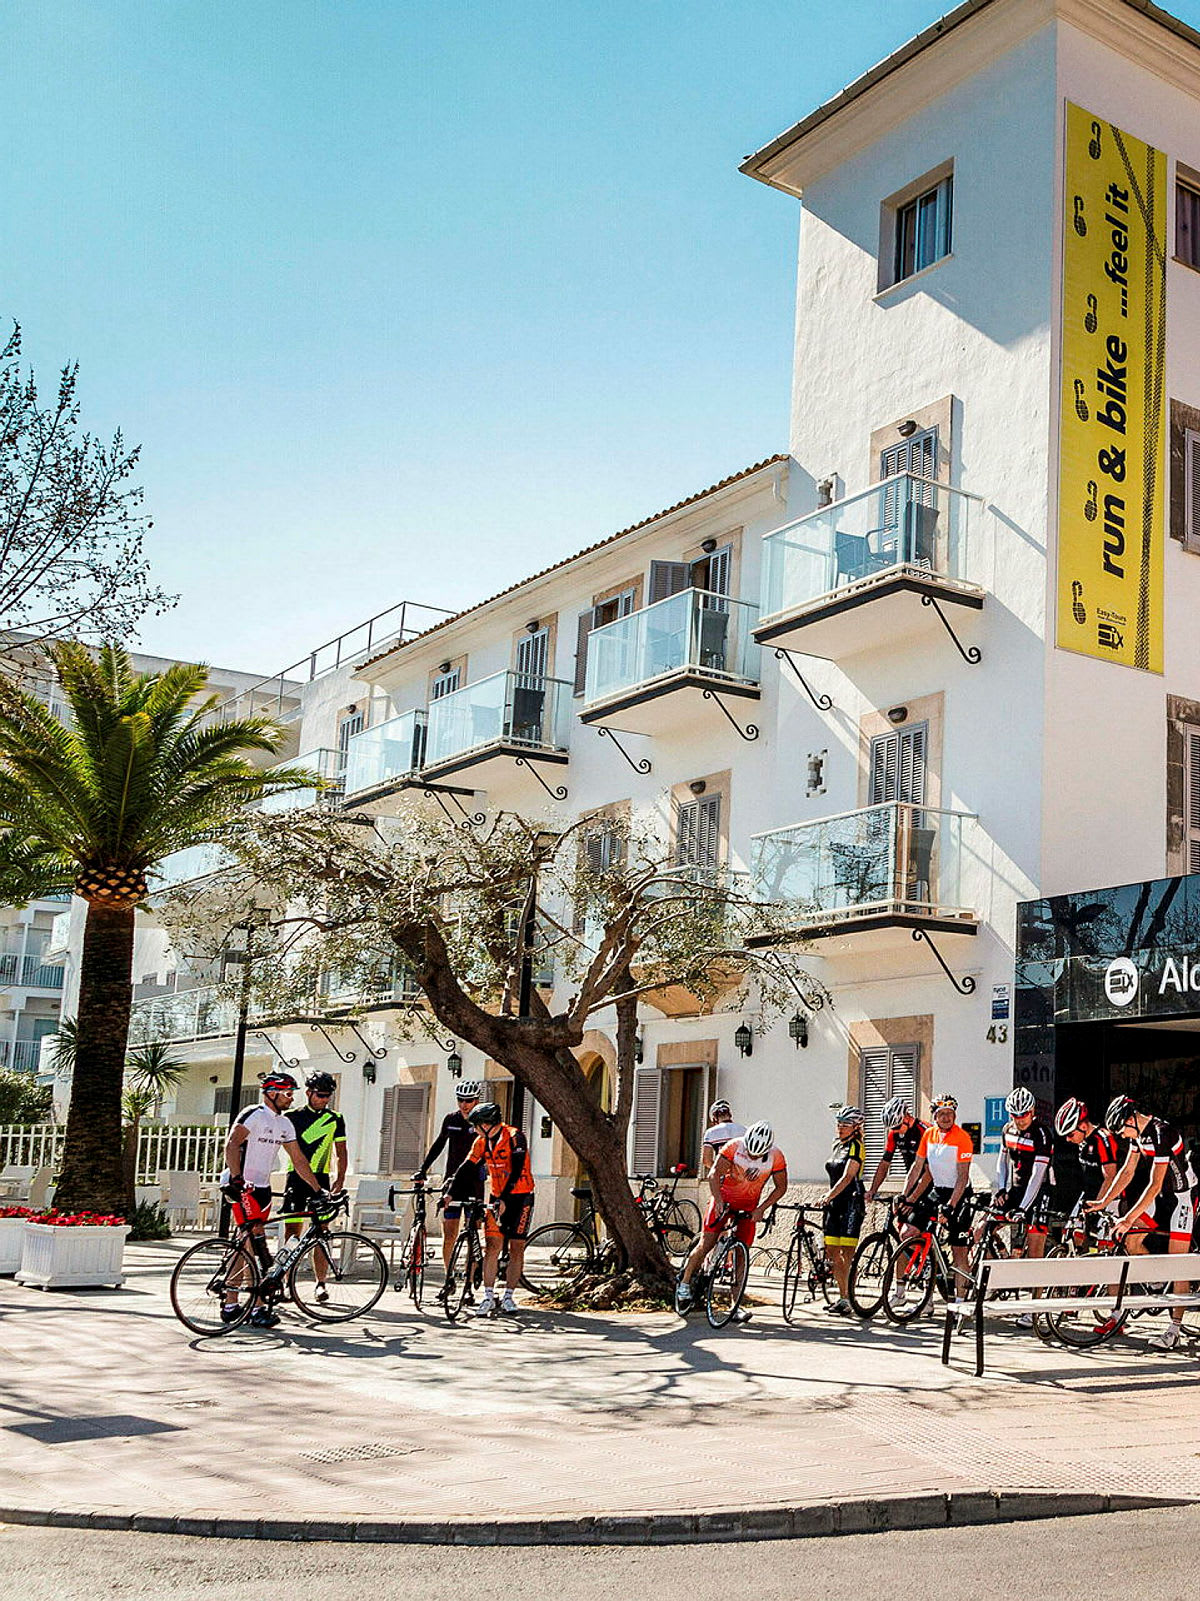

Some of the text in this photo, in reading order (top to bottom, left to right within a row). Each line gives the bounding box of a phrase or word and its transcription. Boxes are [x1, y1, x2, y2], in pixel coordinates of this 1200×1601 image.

[1105, 182, 1129, 215] it
[1097, 335, 1128, 436] bike
[1098, 444, 1127, 483] &
[1103, 493, 1125, 579] run
[986, 1024, 1008, 1044] 43
[992, 1100, 1003, 1121] H
